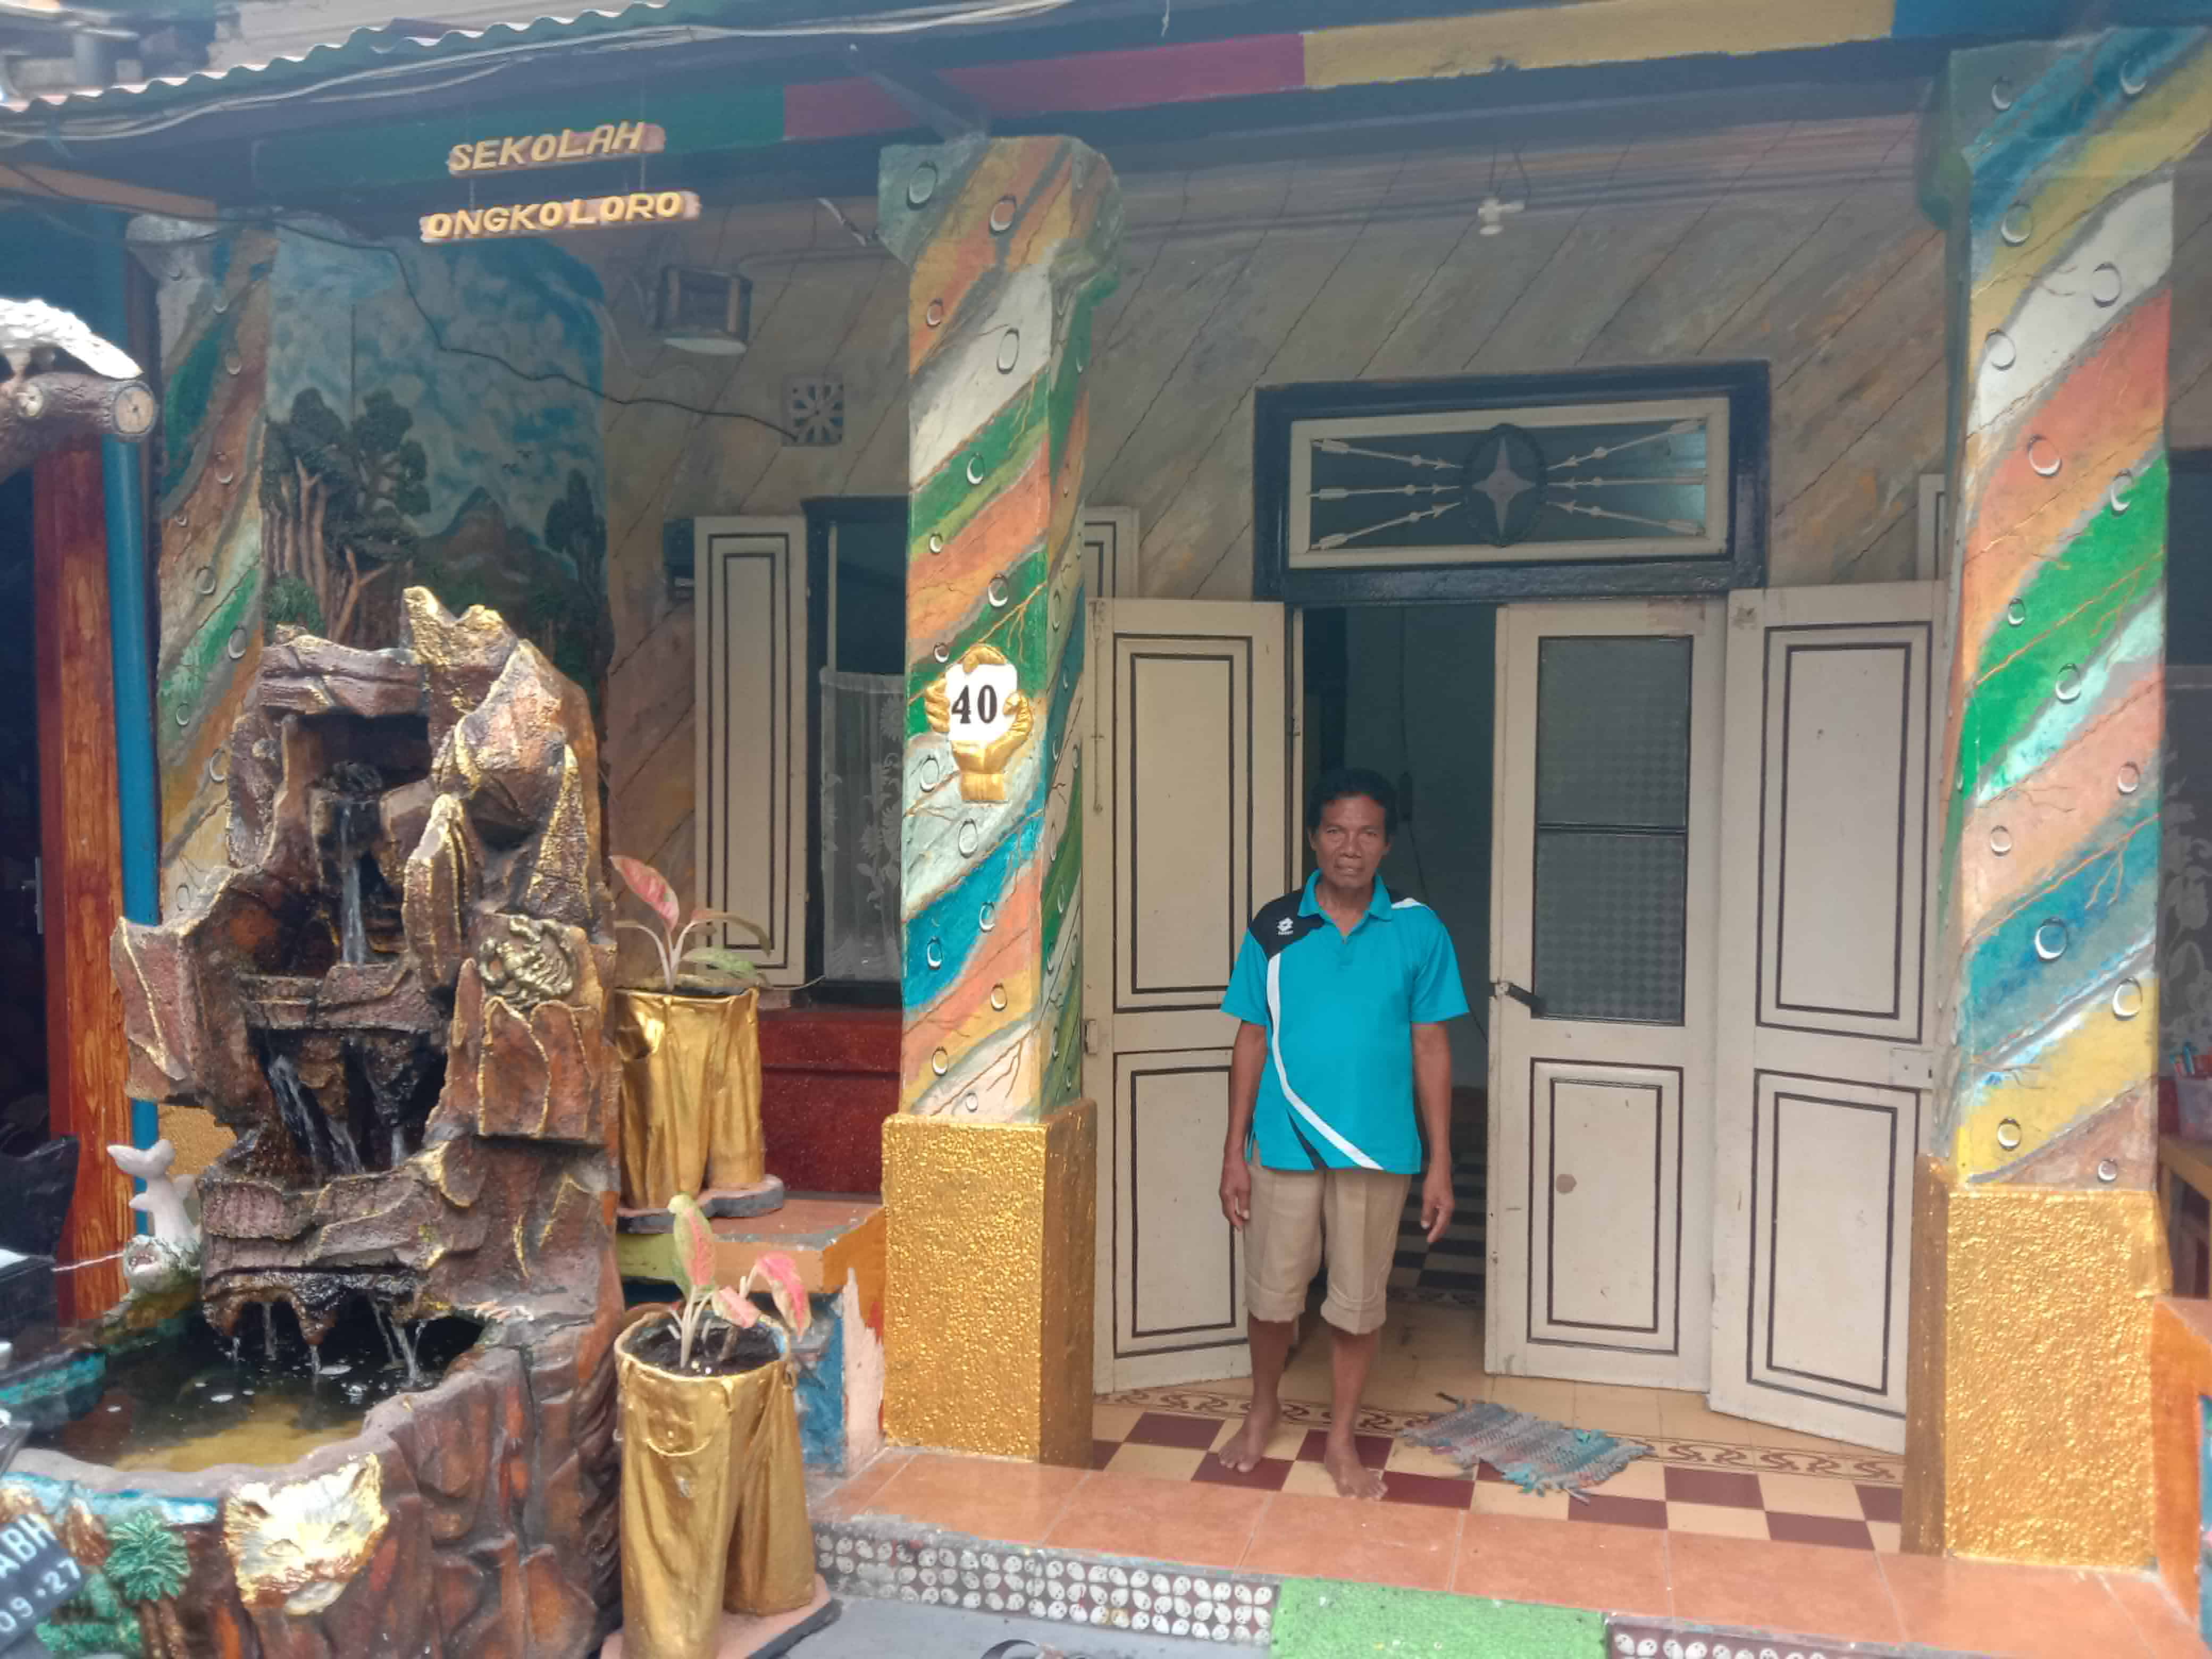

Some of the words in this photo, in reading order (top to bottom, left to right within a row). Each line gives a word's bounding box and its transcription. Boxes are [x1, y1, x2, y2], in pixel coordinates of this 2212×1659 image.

[448, 121, 645, 171] SEKOLAH
[428, 191, 681, 238] ONGKOLORO
[951, 684, 998, 724] 40
